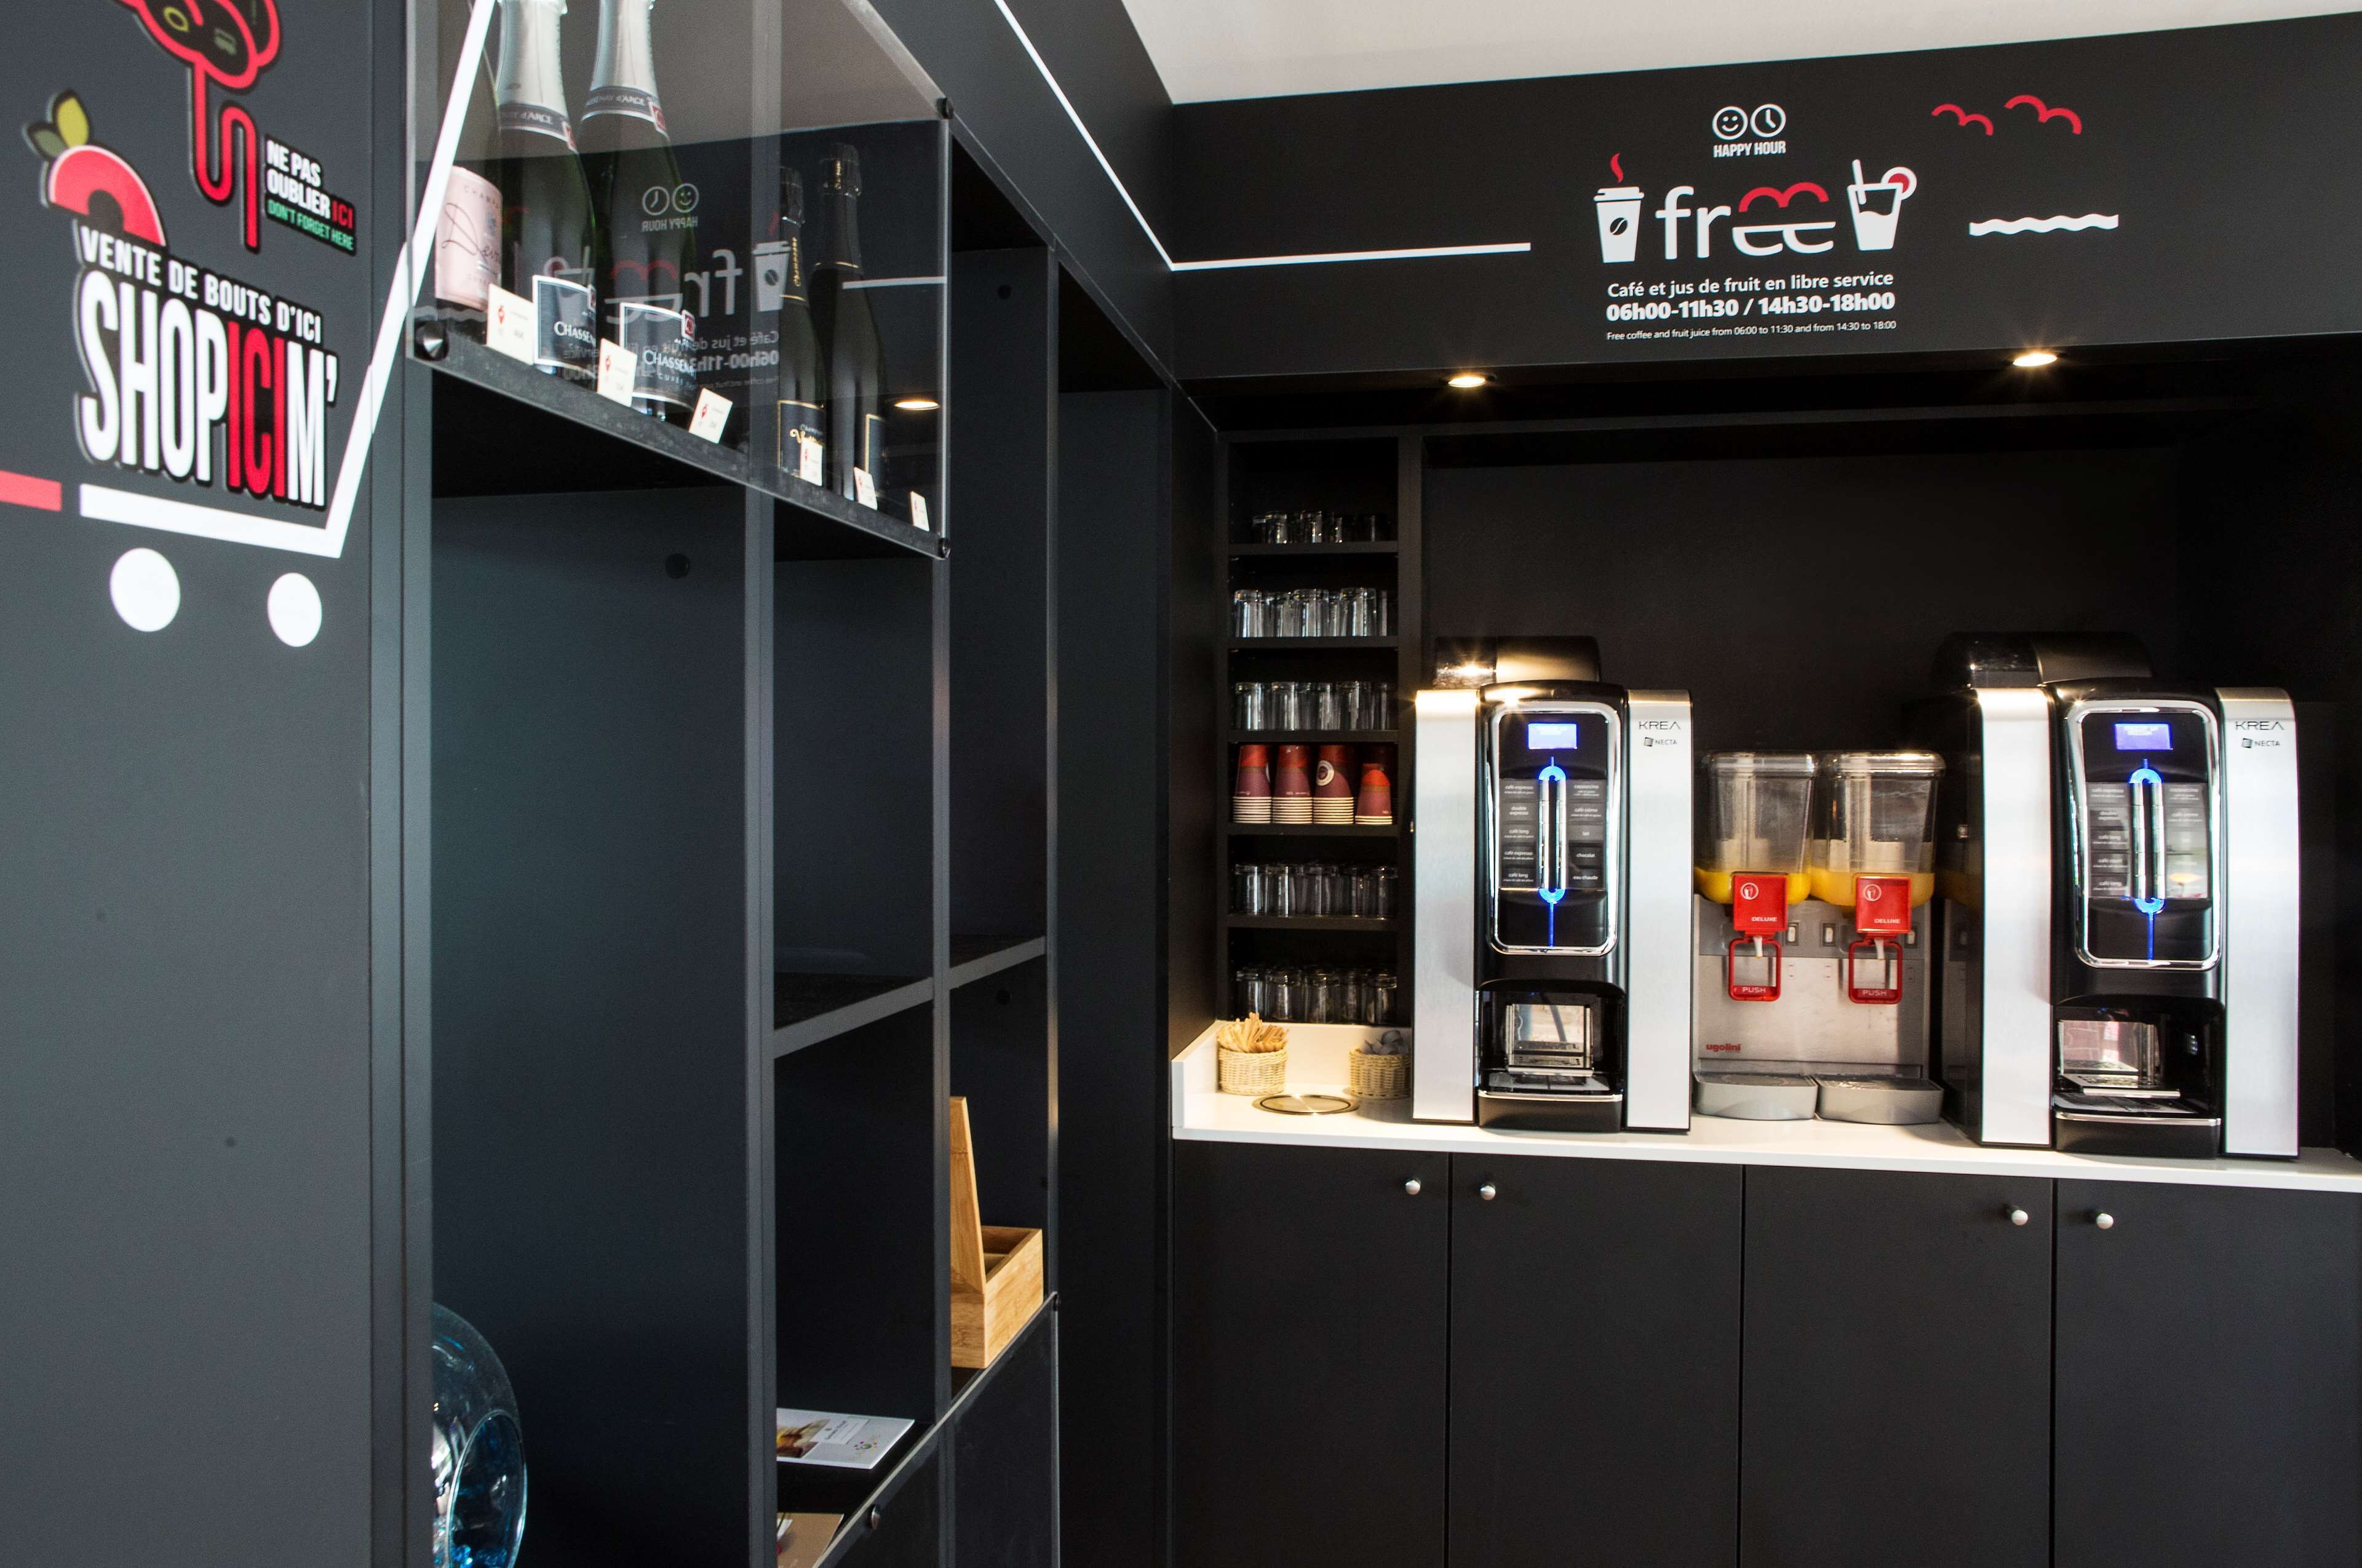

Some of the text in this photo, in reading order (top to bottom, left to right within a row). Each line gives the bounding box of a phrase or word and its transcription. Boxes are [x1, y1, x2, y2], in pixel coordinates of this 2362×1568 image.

[266, 139, 322, 188] NE PAS
[1713, 140, 1786, 158] HAPPY HOUR
[266, 168, 354, 229] OUBLIER ICI
[267, 199, 354, 251] DON'T FORGET HERE
[1655, 181, 1837, 260] free
[81, 226, 321, 344] VENTE DE BOUTS D'ICI
[1607, 271, 1894, 299] Café et jus de fruit en libre service
[1606, 292, 1896, 322] 06h00-11h30 / 14h30-18h00
[1607, 332, 1625, 341] Free
[1626, 330, 1653, 340] coffee
[1653, 330, 1670, 339] and
[1671, 328, 1689, 338] fruit
[1690, 328, 1710, 339] juice
[1711, 327, 1733, 336] from
[1733, 326, 1757, 335] 06:00
[1770, 324, 1794, 334] 11:30
[1794, 324, 1811, 333] and
[1813, 323, 1834, 332] from
[1837, 322, 1860, 331] 14:30
[1873, 320, 1897, 330] 18:00
[1639, 721, 1682, 730] KREA
[2235, 721, 2285, 730] KREA
[1706, 1043, 1741, 1053] ugolini
